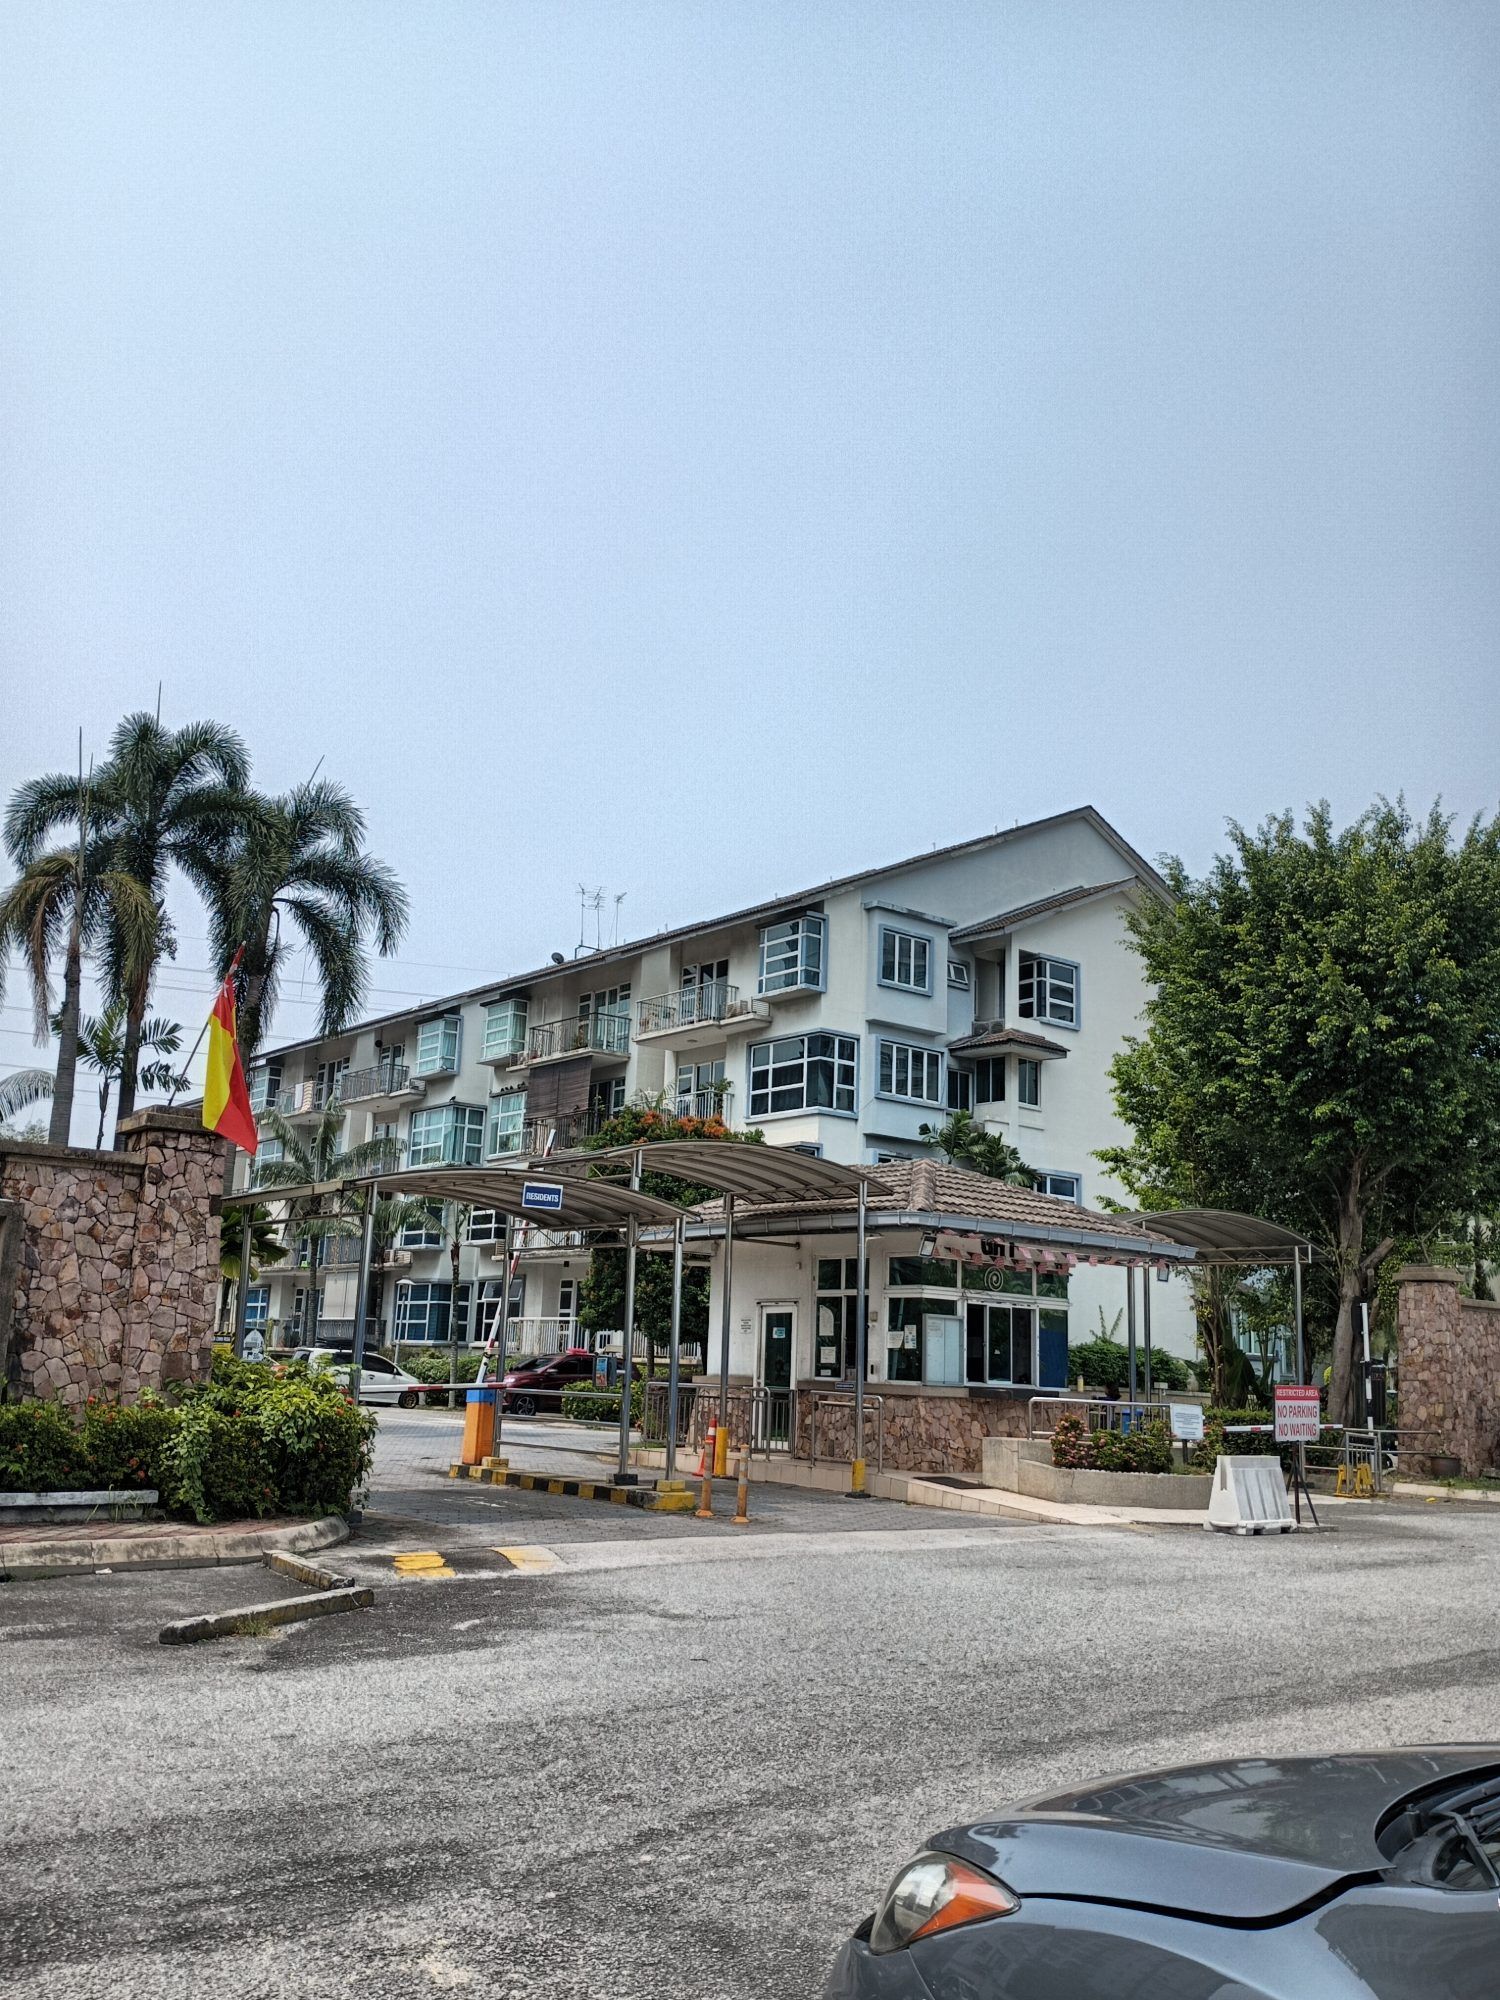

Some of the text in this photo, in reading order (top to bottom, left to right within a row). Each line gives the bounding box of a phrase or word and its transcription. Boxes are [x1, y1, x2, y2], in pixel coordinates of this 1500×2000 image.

[526, 1192, 559, 1203] RESIDENTS
[1305, 1389, 1319, 1397] AREA
[1277, 1405, 1317, 1418] NO PARKING
[1279, 1423, 1317, 1436] NO WAITING
